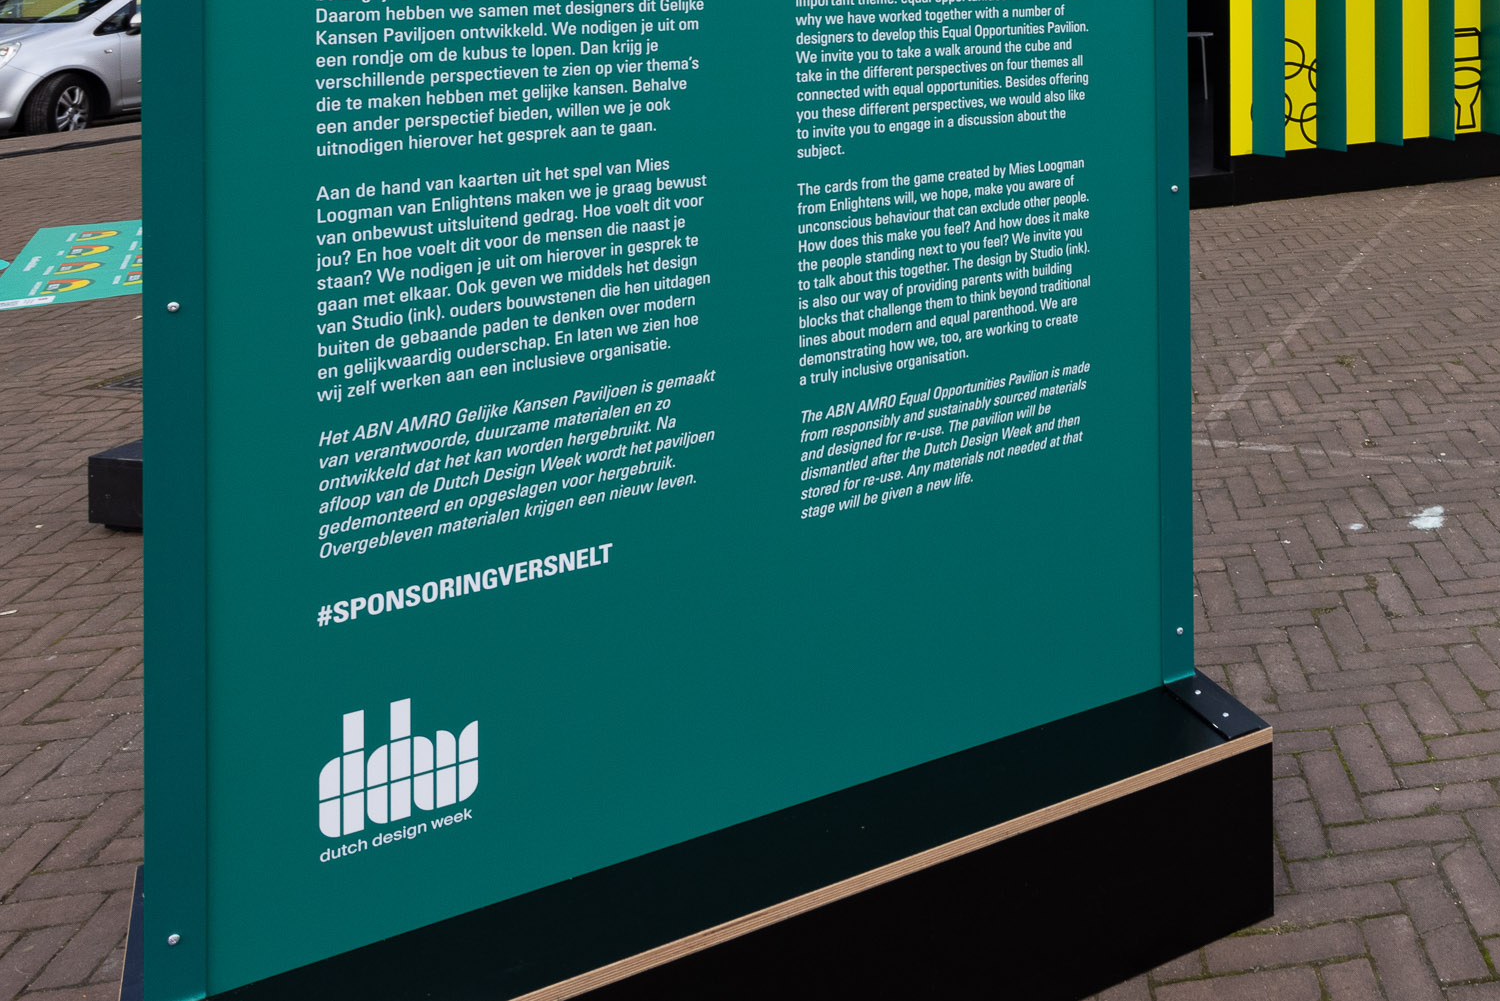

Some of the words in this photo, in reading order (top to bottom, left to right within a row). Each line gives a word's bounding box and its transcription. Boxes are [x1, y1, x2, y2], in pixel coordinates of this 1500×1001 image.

[796, 143, 845, 160] subject.
[799, 375, 807, 386] a
[810, 368, 839, 384] truly
[841, 360, 893, 379] inclusive
[896, 348, 969, 371] organisation.
[318, 498, 441, 540] gedemonteerd
[444, 498, 464, 513] en
[468, 480, 558, 509] opgeslagen
[561, 472, 595, 489] voor
[597, 455, 676, 483] hergebruik.
[316, 542, 614, 628] #SPONSORINGVERSNELT
[320, 838, 368, 863] dutch
[372, 822, 427, 847] design
[431, 808, 473, 830] week
